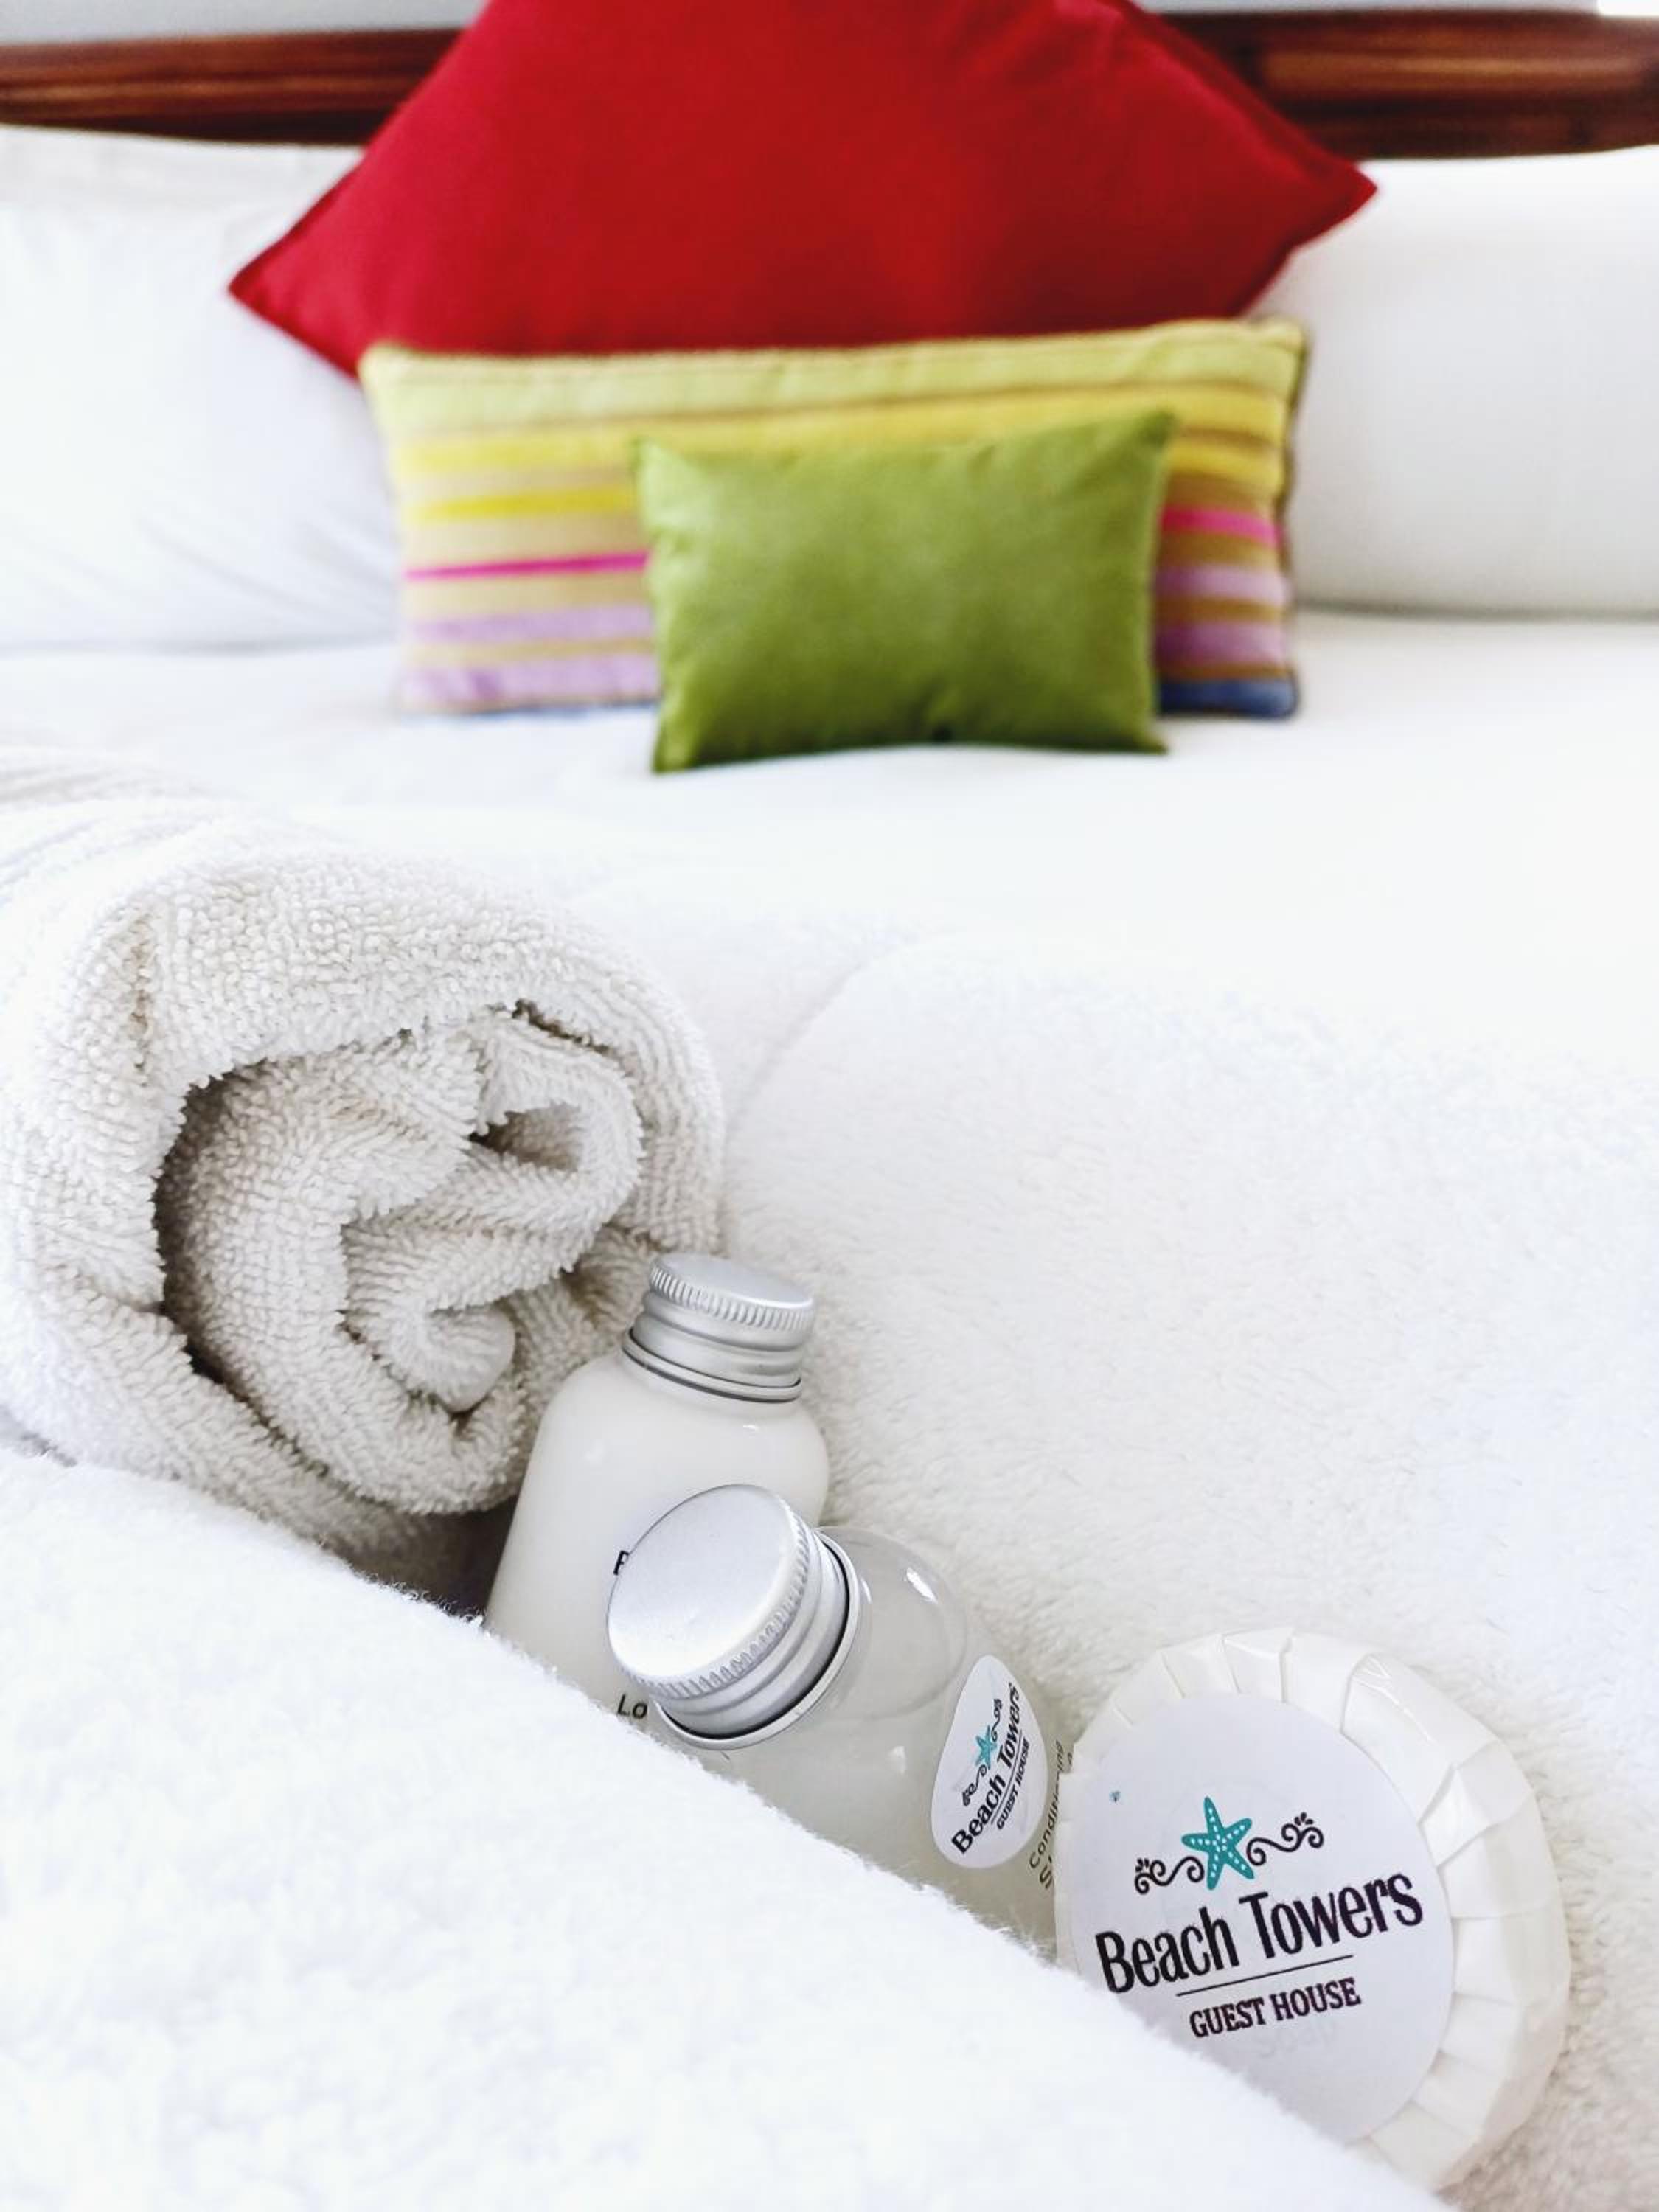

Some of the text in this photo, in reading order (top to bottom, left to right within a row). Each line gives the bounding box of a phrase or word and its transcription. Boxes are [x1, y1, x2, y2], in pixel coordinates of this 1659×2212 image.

[951, 1682, 1020, 1854] Beach Towers
[996, 1739, 1030, 1831] GUEST HOUSE
[1095, 1873, 1423, 1994] Beach Towers
[1189, 1976, 1363, 2038] GUEST HOUSE
